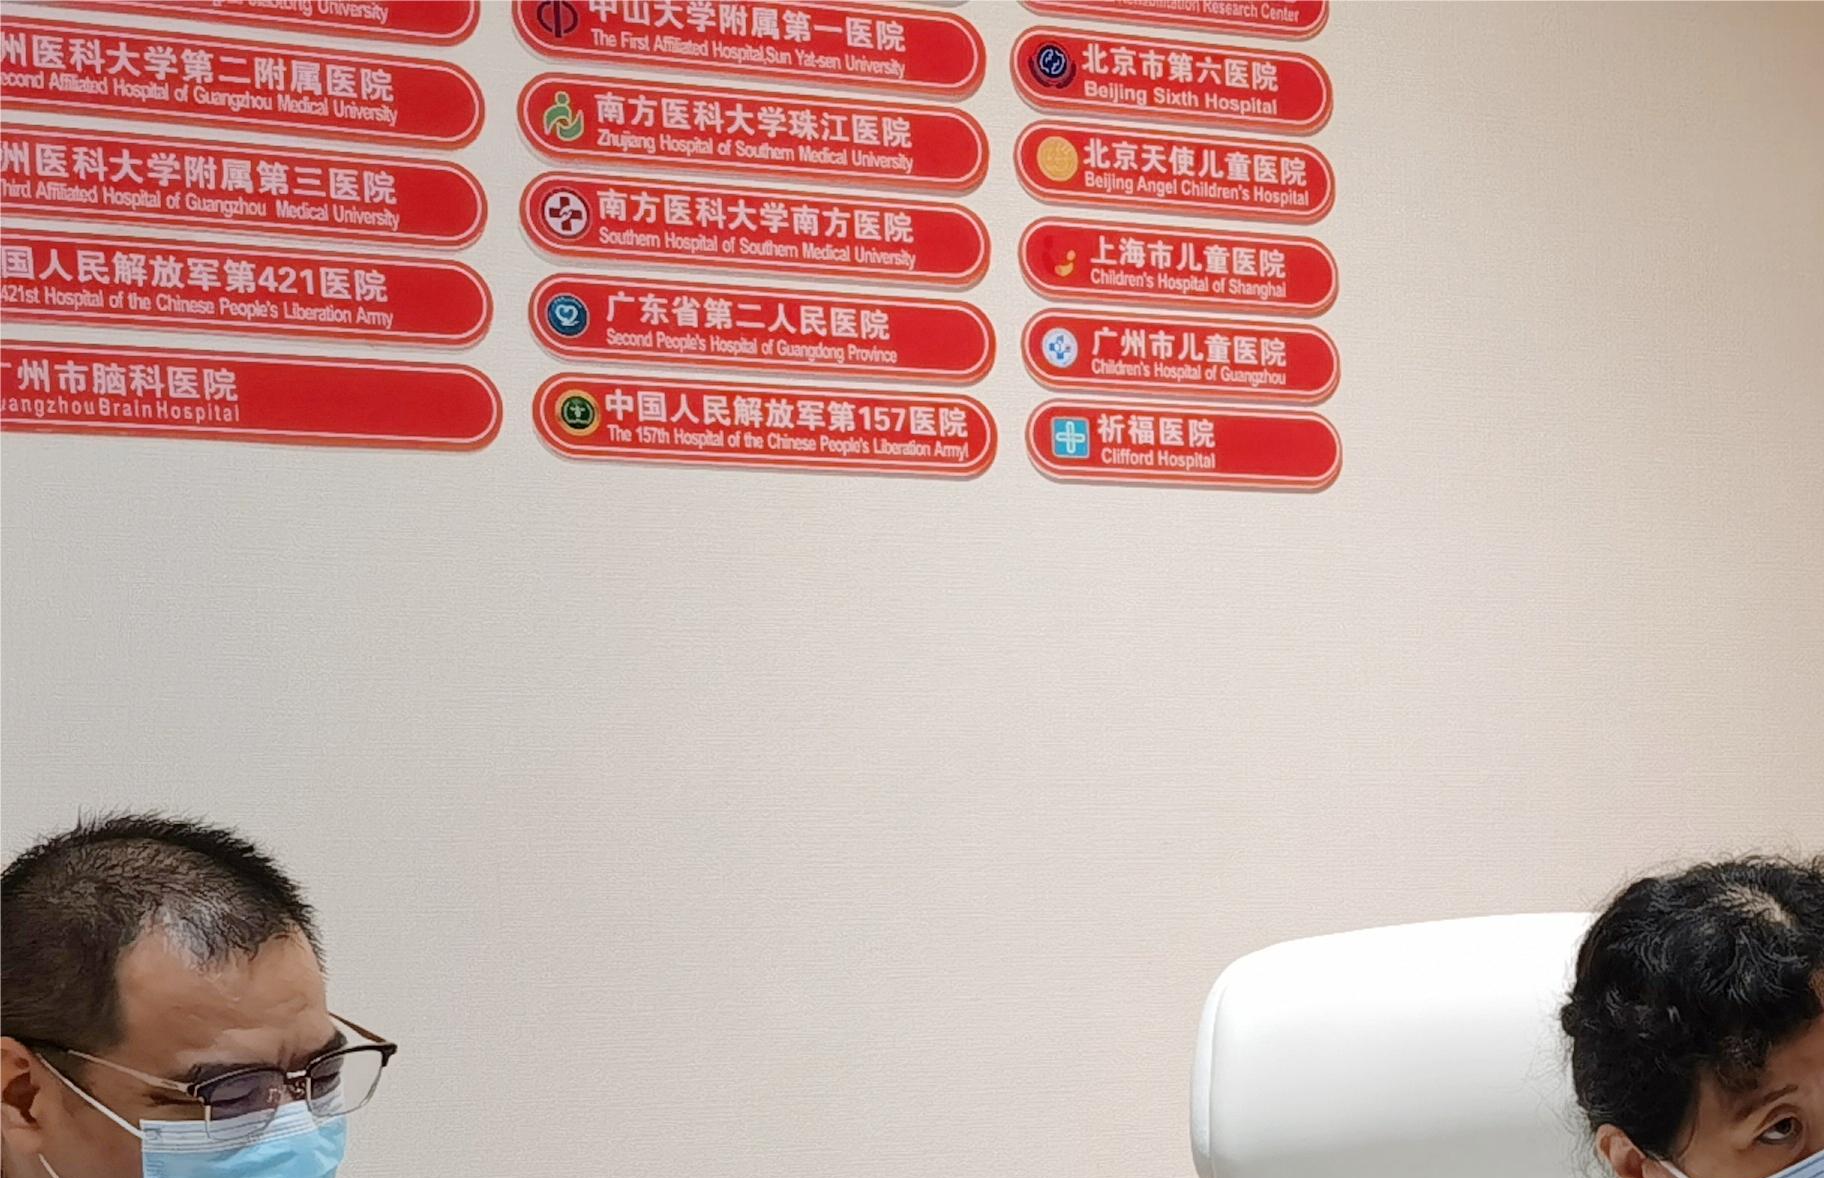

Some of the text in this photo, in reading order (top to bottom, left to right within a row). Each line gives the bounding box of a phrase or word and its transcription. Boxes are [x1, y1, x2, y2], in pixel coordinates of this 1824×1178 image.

[318, 1, 389, 23] University
[588, 0, 906, 52] 中山大学附属第一医院
[1203, 1, 1257, 17] Research
[1260, 4, 1299, 22] Center
[0, 32, 394, 102] 州医科大学第二附属医院
[590, 28, 616, 47] The
[620, 30, 650, 50] First
[653, 34, 708, 57] Affiliated
[795, 48, 841, 70] Yat-sen
[845, 54, 905, 79] University
[1082, 43, 1279, 92] 北京市第六医院
[50, 72, 108, 95] Affiliated
[113, 77, 169, 102] Hospital
[174, 85, 188, 102] of
[193, 86, 272, 111] Guangzhou
[277, 93, 328, 116] Medical
[333, 99, 397, 127] University
[594, 91, 912, 148] 南方医科大学珠江医院
[1084, 80, 1277, 116] Beijing Sixth Hospital
[0, 141, 397, 204] 州医科大学附属第三医院
[597, 128, 913, 174] Zhujiang Hospital of Southern Medical University
[1083, 137, 1307, 187] 北京天使儿童医院
[36, 181, 98, 203] Affiliated
[102, 186, 161, 210] Hospital
[166, 193, 181, 209] of
[186, 193, 266, 218] Guangzhou
[276, 200, 328, 221] Medical
[333, 204, 399, 232] University
[1084, 171, 1309, 207] Beijing Angel Children's Hospital
[596, 188, 914, 244] 南方医科大学南方医院
[599, 226, 916, 271] Southern Hospital of Southern Medical University
[1090, 235, 1286, 278] 上海市儿童医院
[0, 245, 388, 302] 国人民解放军第421医院
[1090, 268, 1286, 300] Children's Hospital of Shanghai
[44, 286, 104, 311] Hospital
[109, 291, 123, 309] of
[128, 292, 151, 311] the
[155, 293, 215, 314] Chinese
[219, 297, 278, 321] People's
[283, 301, 351, 323] Liberation
[356, 306, 393, 330] Army
[606, 291, 890, 340] 广东省第二人民医院
[606, 328, 897, 364] Second People's Hospital of Guangdong Province
[1091, 326, 1287, 367] 广州市儿童医院
[1091, 358, 1286, 387] Children's Hospital of Guangzhou
[605, 388, 968, 438] 中国人民解放军第157医院
[1097, 413, 1216, 448] 祈福医院
[607, 424, 632, 442] The
[636, 426, 670, 444] 157th
[674, 427, 724, 449] Hospital
[728, 431, 741, 448] of
[743, 432, 763, 449] the
[767, 433, 816, 451] Chinese
[820, 435, 869, 456] People's
[873, 438, 931, 457] Liberation
[1101, 448, 1216, 471] Clifford Hospital
